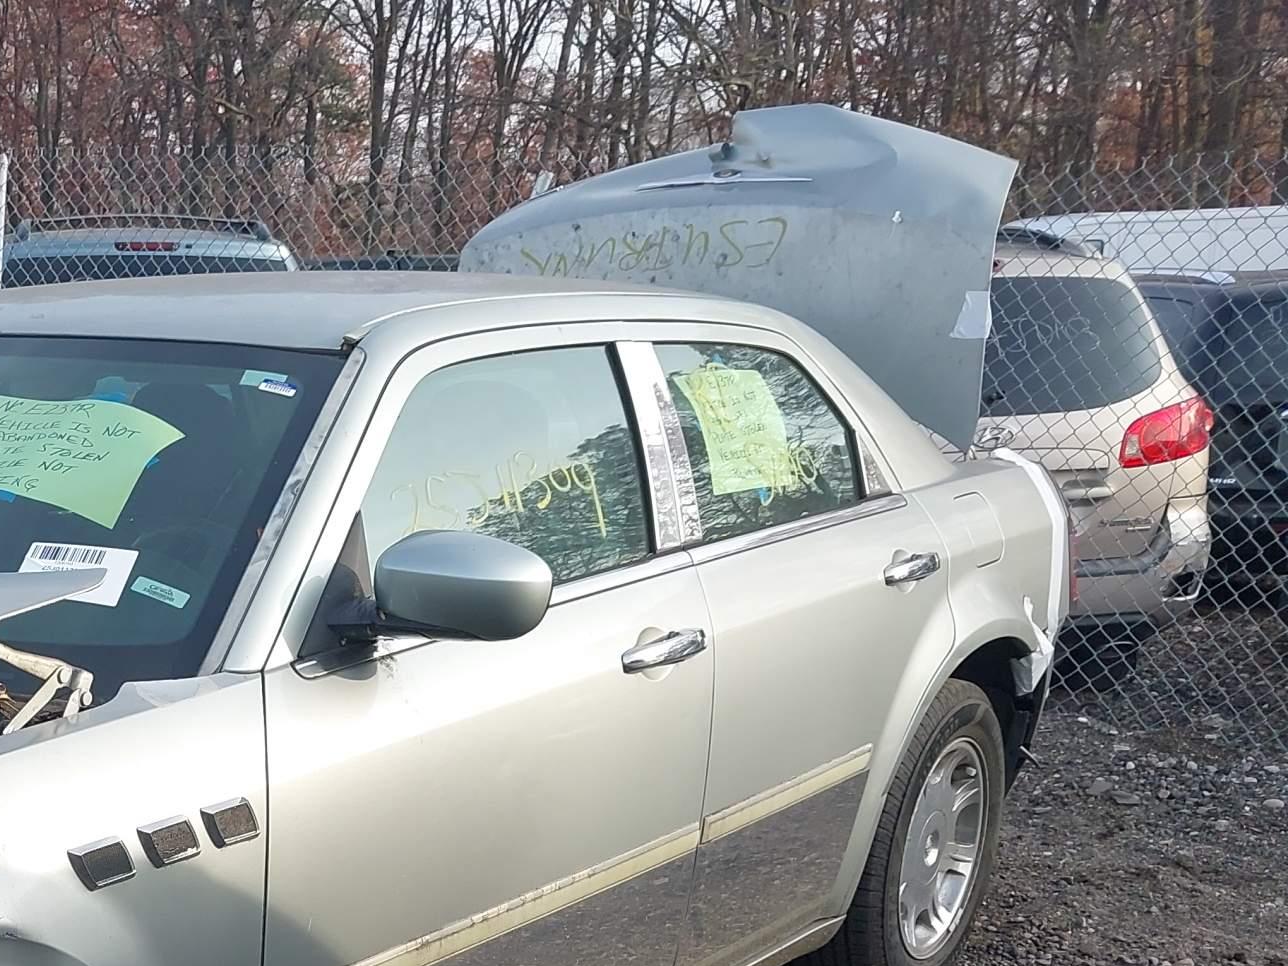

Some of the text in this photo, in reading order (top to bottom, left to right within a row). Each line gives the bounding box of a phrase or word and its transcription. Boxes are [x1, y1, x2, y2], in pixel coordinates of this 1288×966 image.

[102, 421, 141, 439] NOT
[37, 443, 111, 463] STOLEN
[38, 459, 80, 475] NOT
